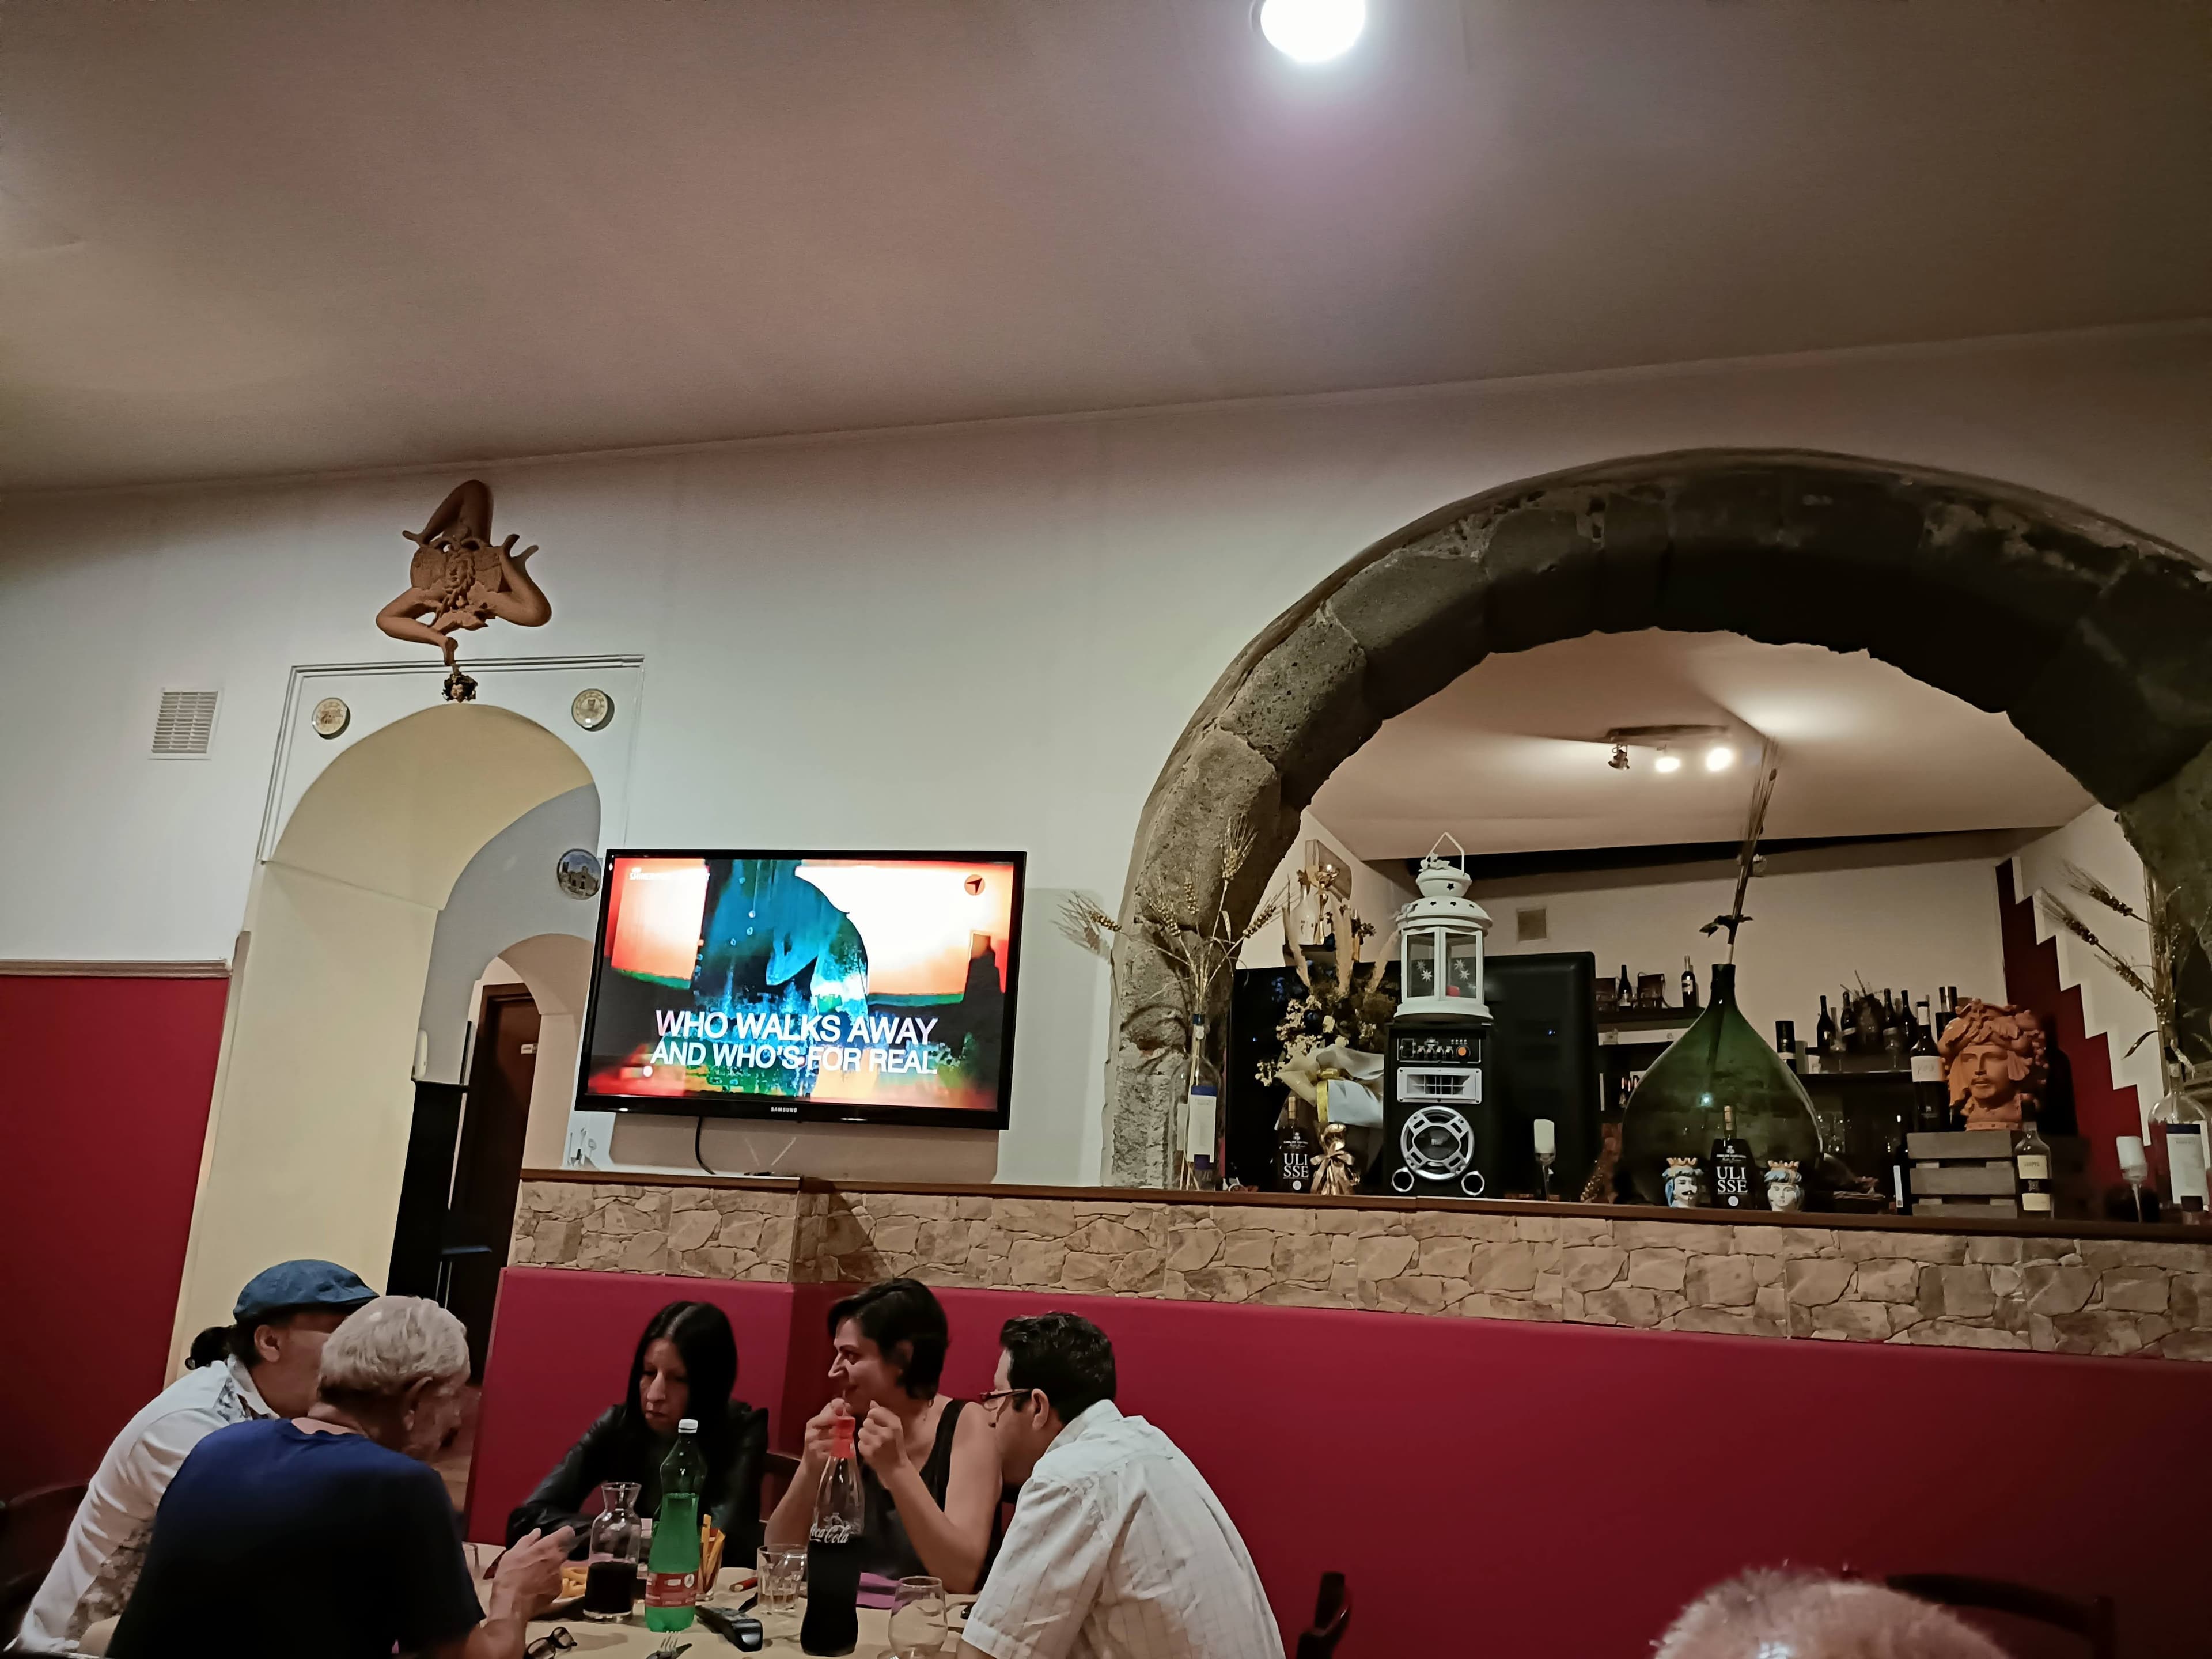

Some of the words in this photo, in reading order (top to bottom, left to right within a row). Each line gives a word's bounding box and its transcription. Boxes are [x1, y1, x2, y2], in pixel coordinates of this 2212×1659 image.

[656, 1010, 728, 1039] WHO
[736, 1012, 841, 1042] WALKS
[847, 1016, 938, 1046] AWAY
[649, 1041, 706, 1066] AND
[713, 1043, 801, 1070] WHO'S
[807, 1046, 862, 1072] FOR
[869, 1048, 938, 1074] REAL
[1283, 1153, 1308, 1166] ULI
[1283, 1165, 1309, 1178] SSE
[1716, 1166, 1747, 1180] ULI
[1717, 1180, 1748, 1193] SSE
